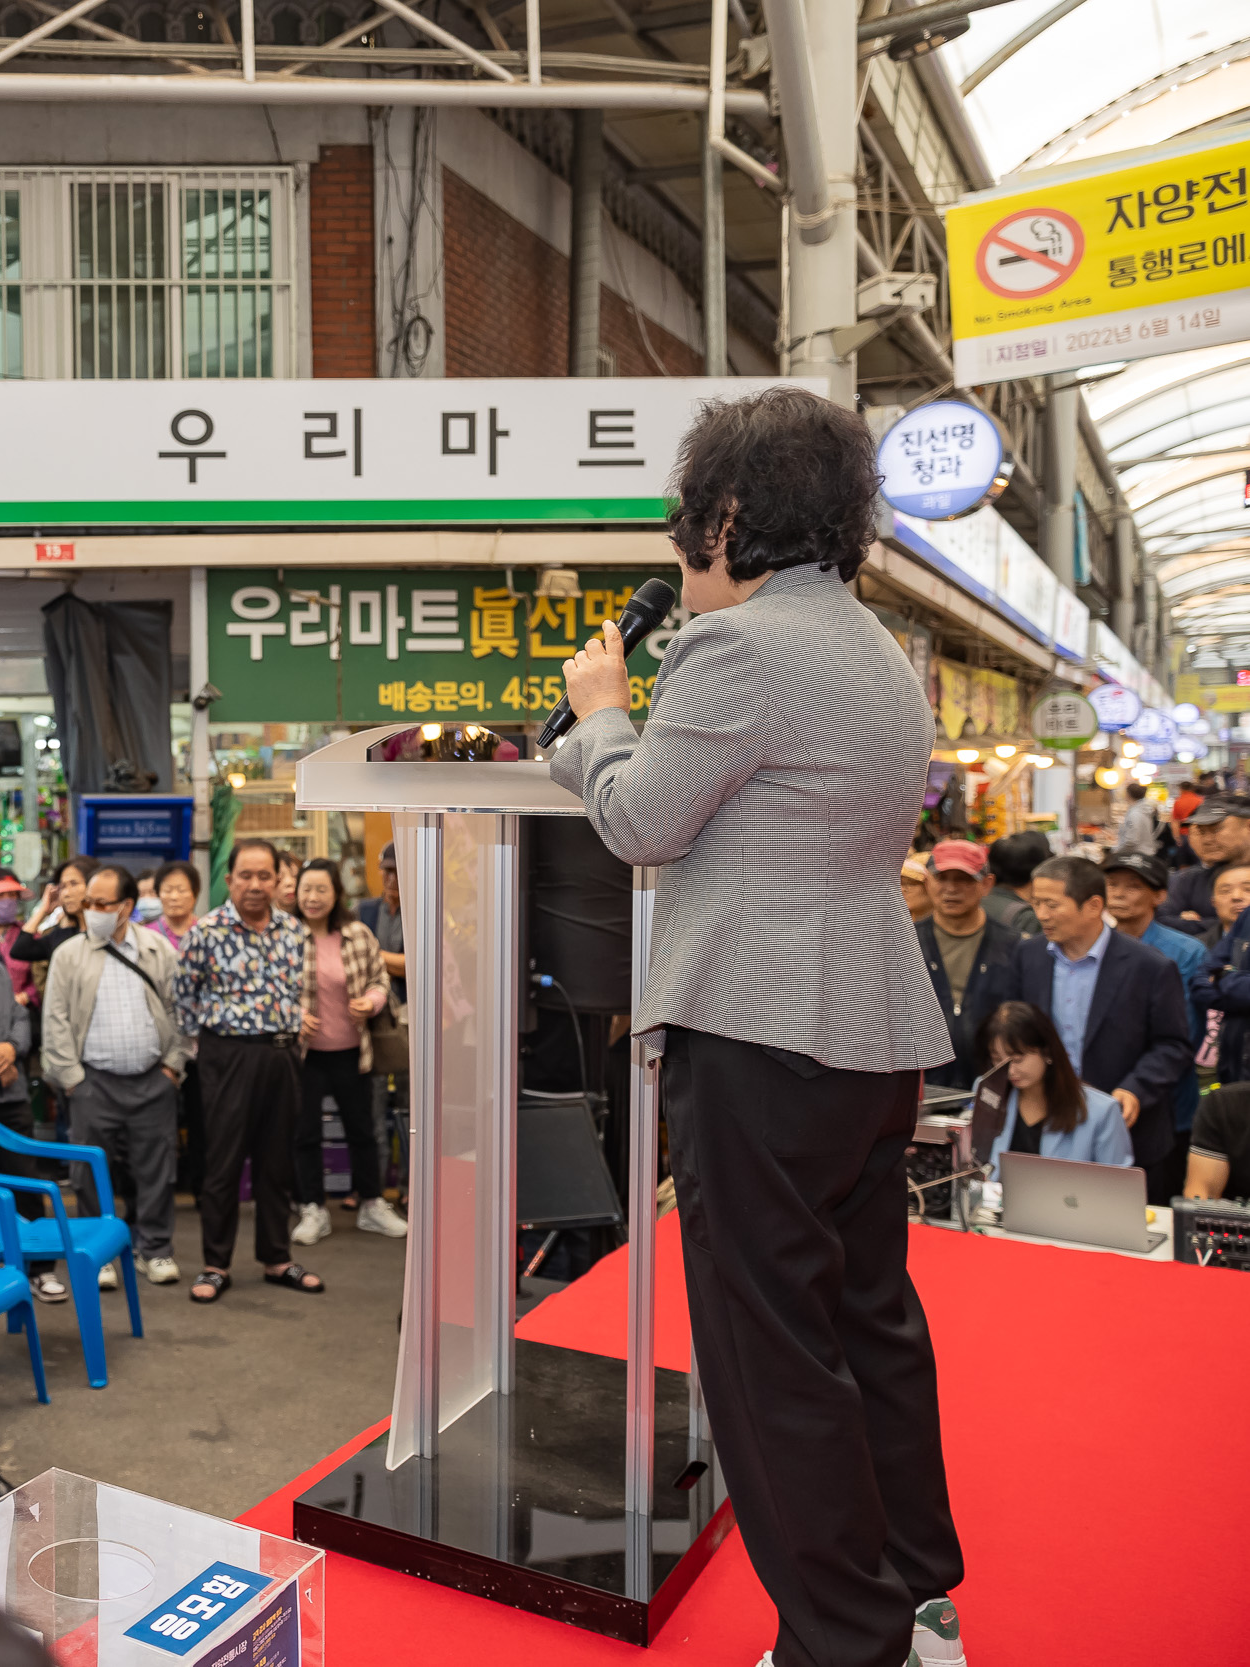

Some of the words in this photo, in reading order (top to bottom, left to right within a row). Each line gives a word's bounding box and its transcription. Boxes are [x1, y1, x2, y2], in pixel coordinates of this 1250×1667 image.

[1108, 233, 1250, 289] 통행로에
[1177, 308, 1222, 332] 14일
[150, 1573, 250, 1641] 응모함
